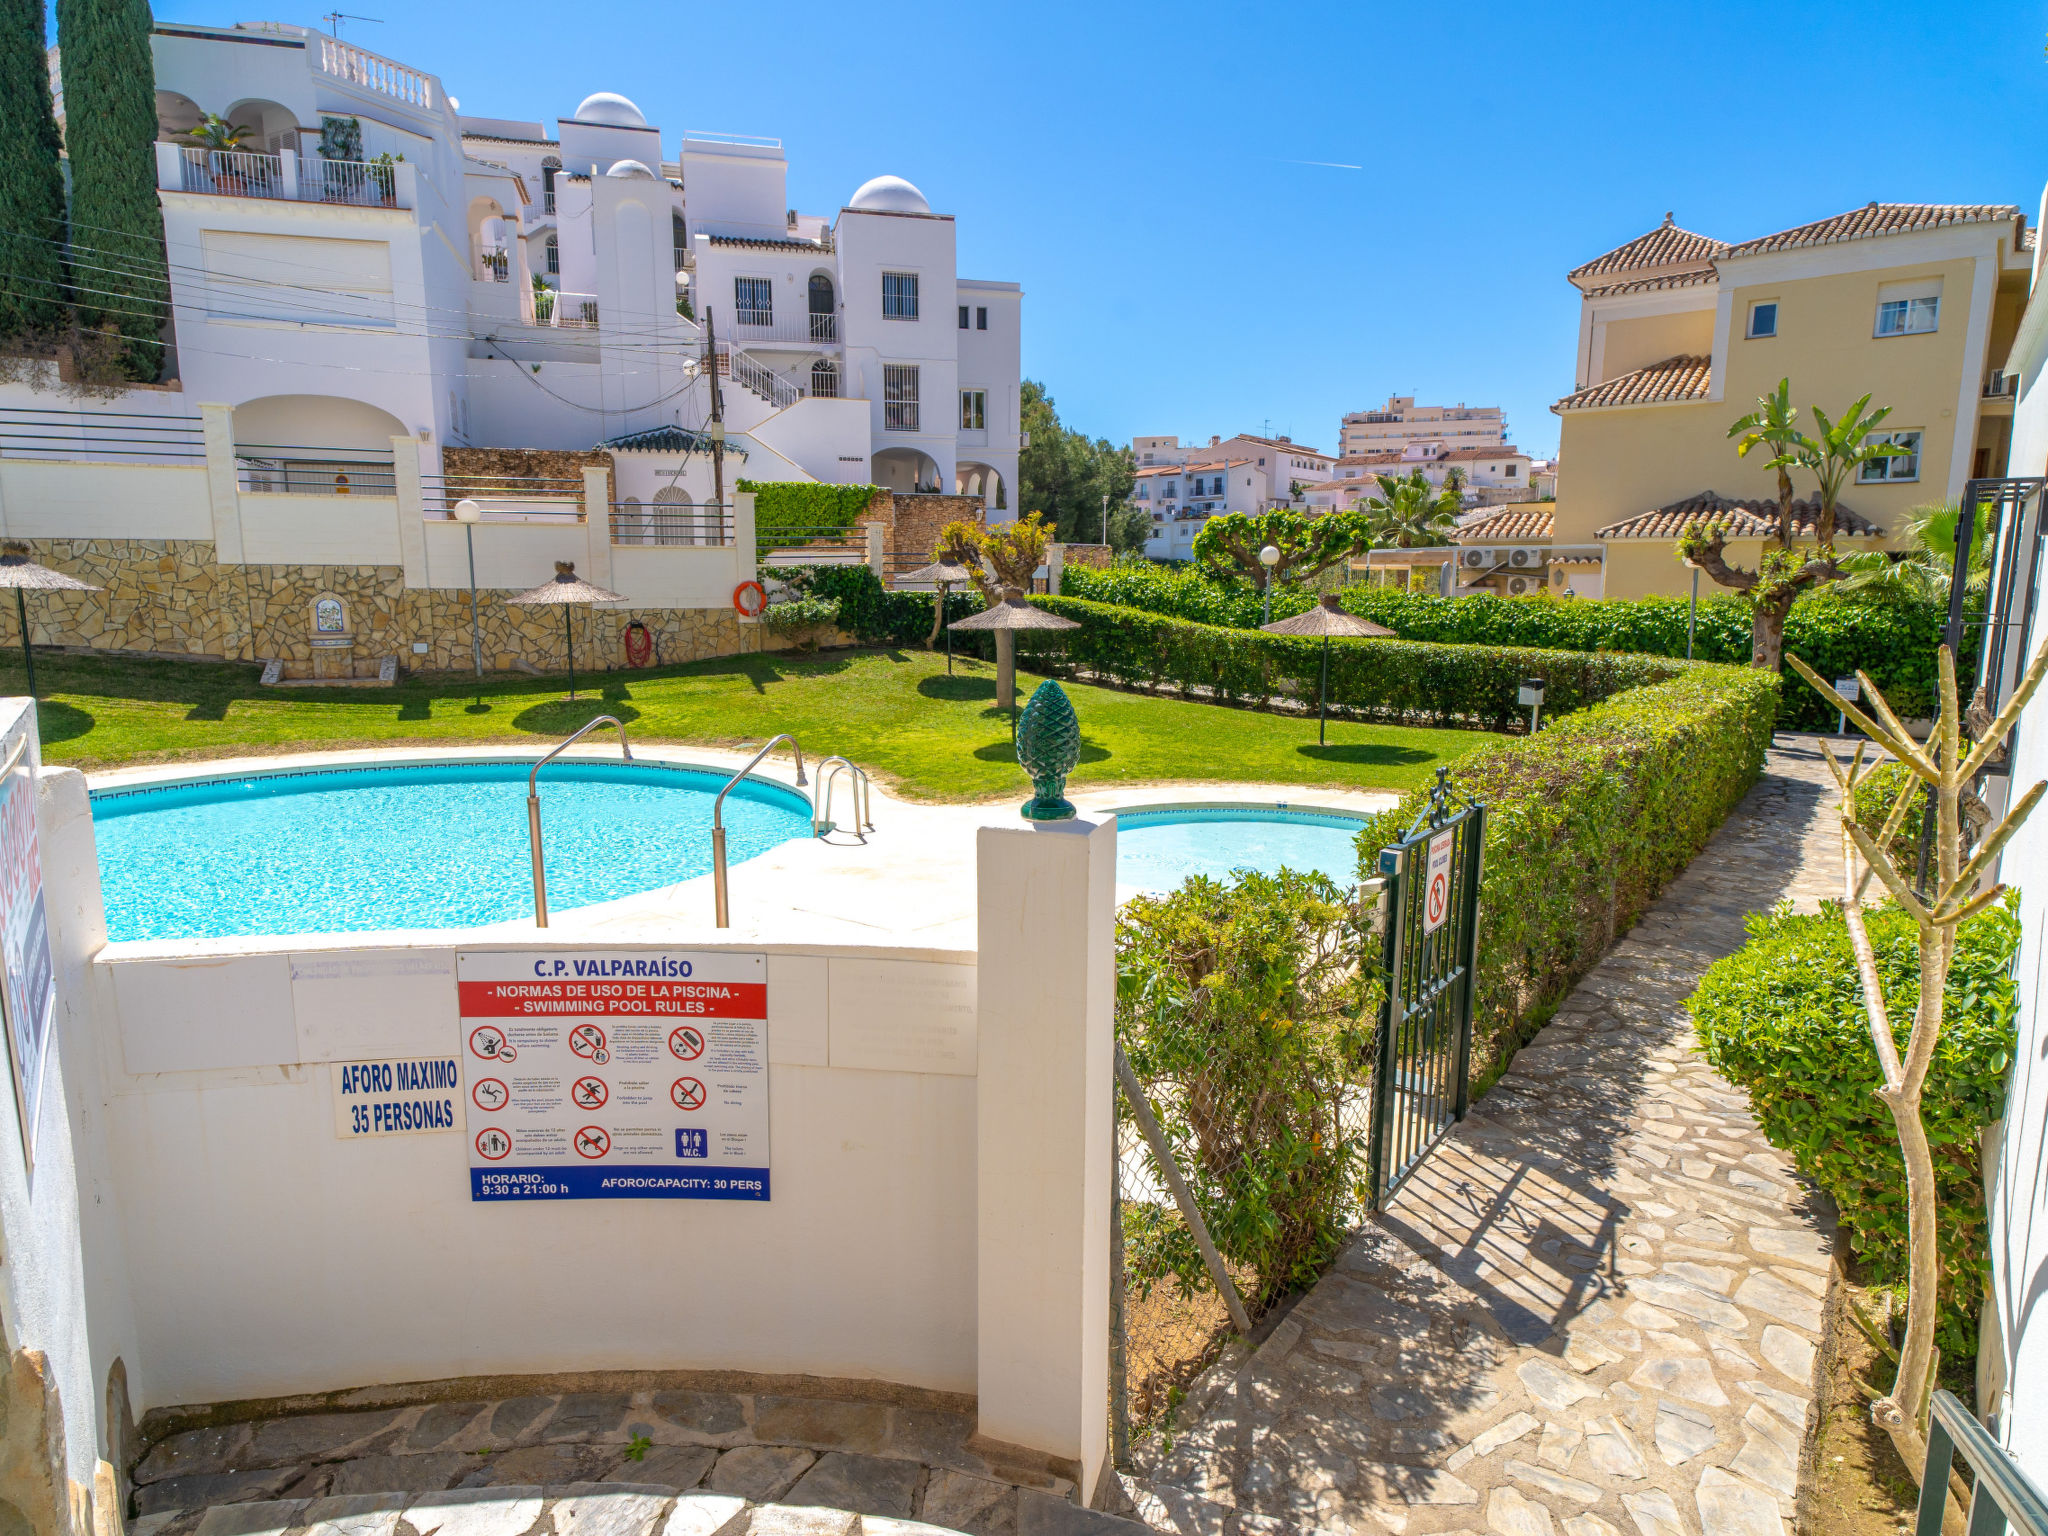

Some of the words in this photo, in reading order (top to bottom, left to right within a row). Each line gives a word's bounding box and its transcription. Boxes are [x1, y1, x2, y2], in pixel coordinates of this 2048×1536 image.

[534, 960, 569, 977] C.P.
[573, 956, 693, 978] VALPARAÍSO
[496, 985, 562, 997] NORMAS
[566, 985, 586, 997] DE
[590, 985, 621, 997] USO
[626, 985, 646, 997] DE
[650, 985, 669, 997] LA
[673, 986, 731, 998] PISCINA
[523, 1001, 605, 1013] SWIMMING
[609, 1000, 651, 1012] POOL
[655, 1001, 705, 1013] RULES
[342, 1063, 393, 1094] AFORO
[397, 1060, 457, 1091] MAXIMO
[352, 1104, 369, 1133] 35
[374, 1099, 453, 1132] PERSONAS
[683, 1148, 701, 1157] W.C.
[482, 1174, 545, 1184] HORARIO:
[601, 1178, 710, 1188] AFORO/CAPACITY:
[714, 1179, 727, 1189] 30
[730, 1180, 762, 1190] PERS
[482, 1185, 508, 1195] 9:30
[512, 1186, 520, 1194] a
[523, 1184, 557, 1194] 21:00
[561, 1184, 568, 1193] h
